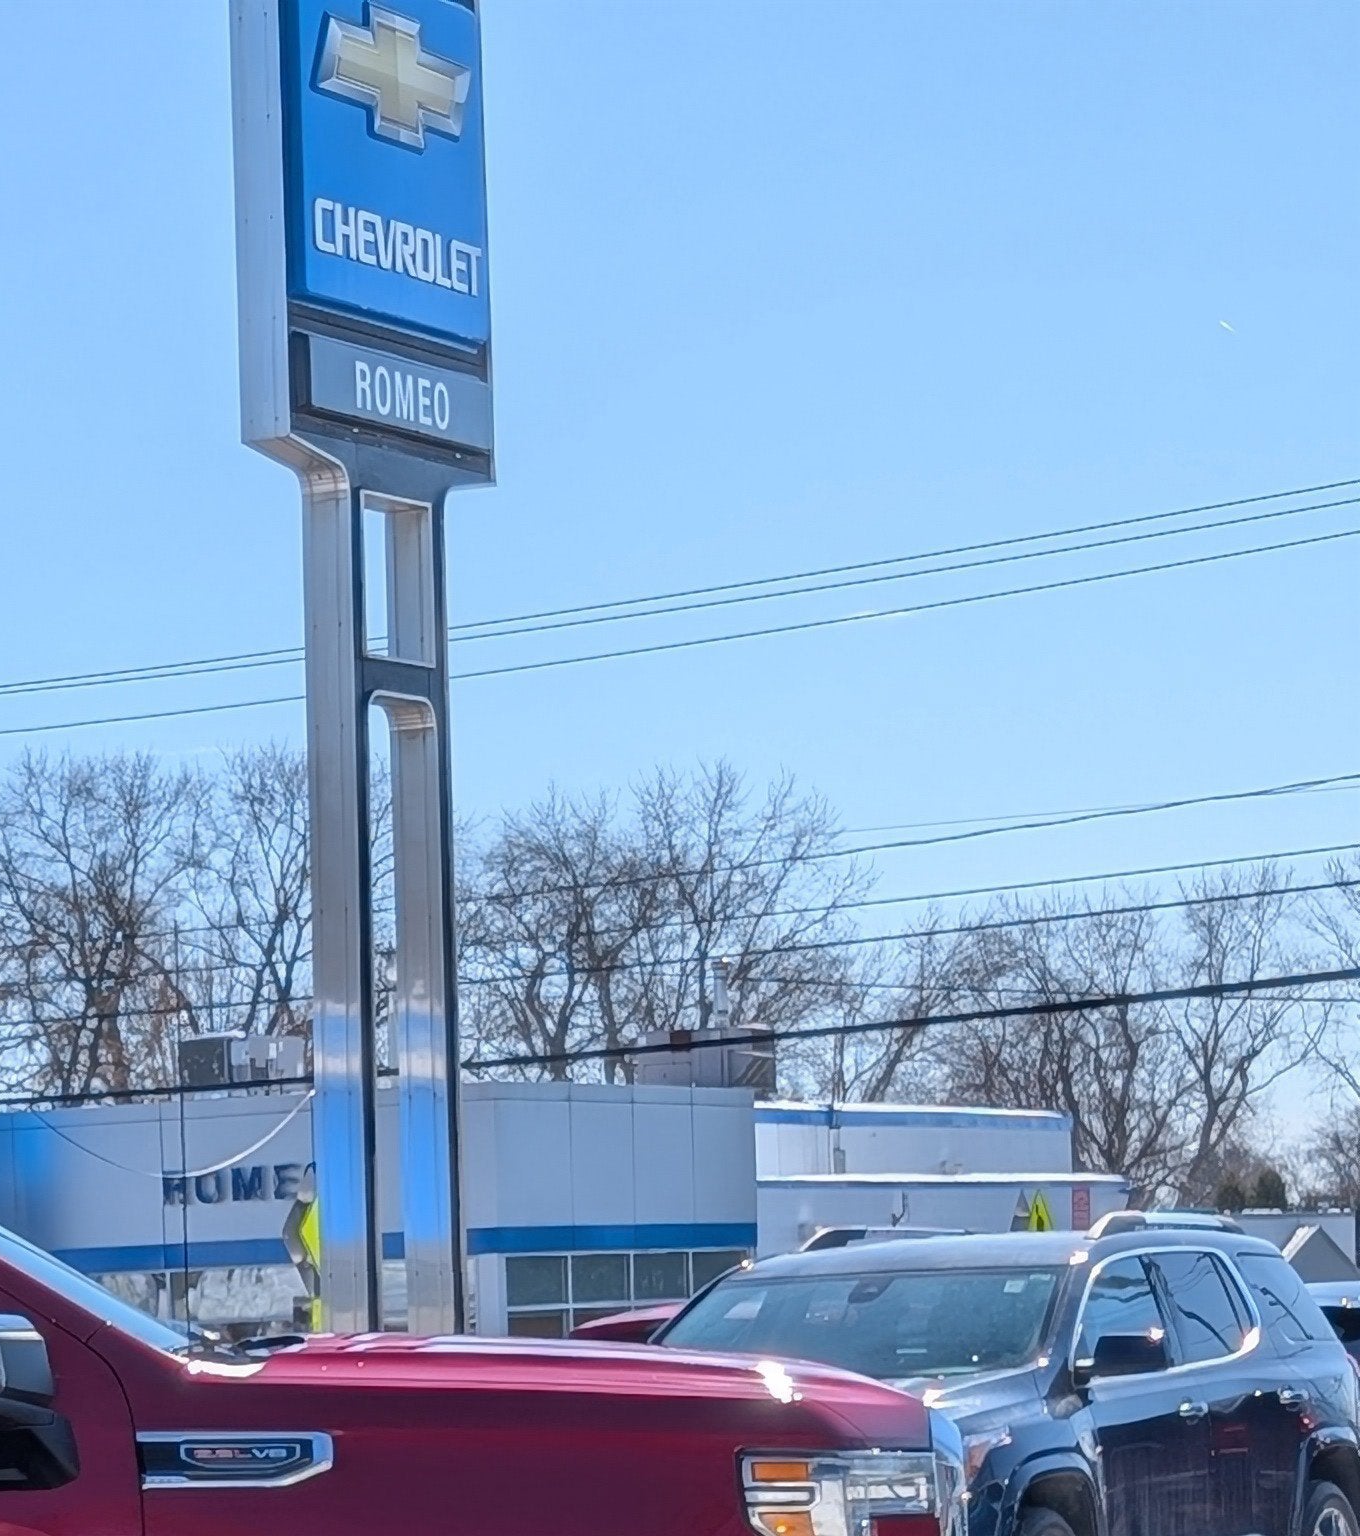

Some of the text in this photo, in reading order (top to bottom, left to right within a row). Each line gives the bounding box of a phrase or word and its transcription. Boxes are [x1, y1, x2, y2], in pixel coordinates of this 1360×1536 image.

[314, 198, 481, 297] CHEVROLET
[355, 360, 449, 430] ROMEO
[161, 1160, 317, 1205] ROME
